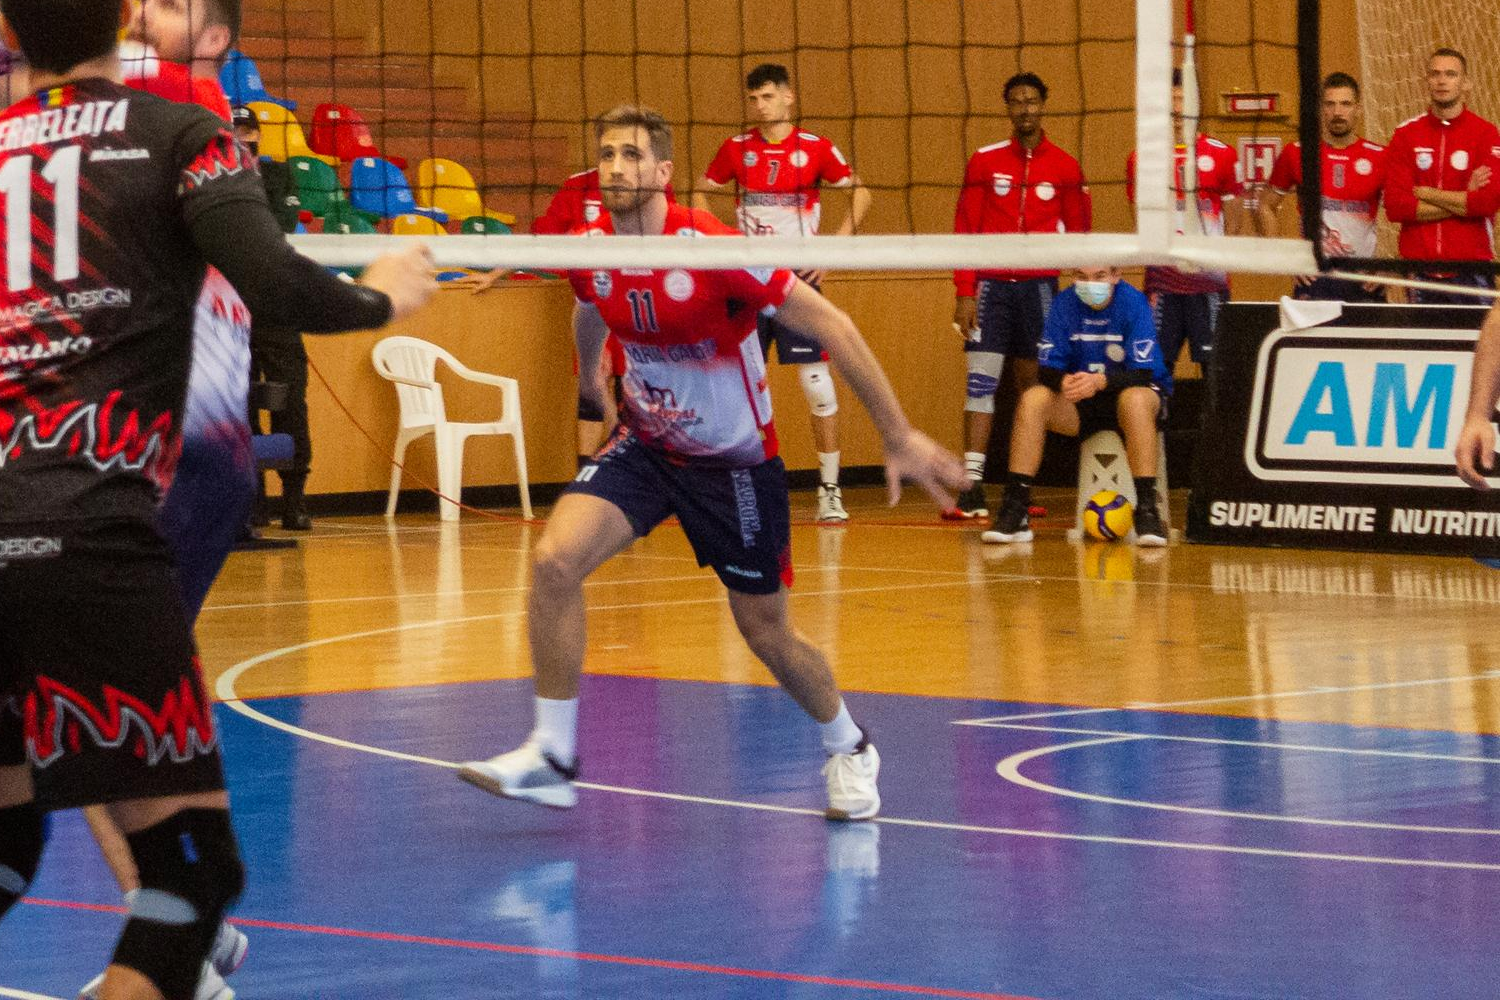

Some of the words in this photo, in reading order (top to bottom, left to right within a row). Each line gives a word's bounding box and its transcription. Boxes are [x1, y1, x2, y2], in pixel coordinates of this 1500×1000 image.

[626, 288, 660, 332] 11
[1284, 361, 1456, 450] AM
[1210, 501, 1377, 532] SUPLIMENTE
